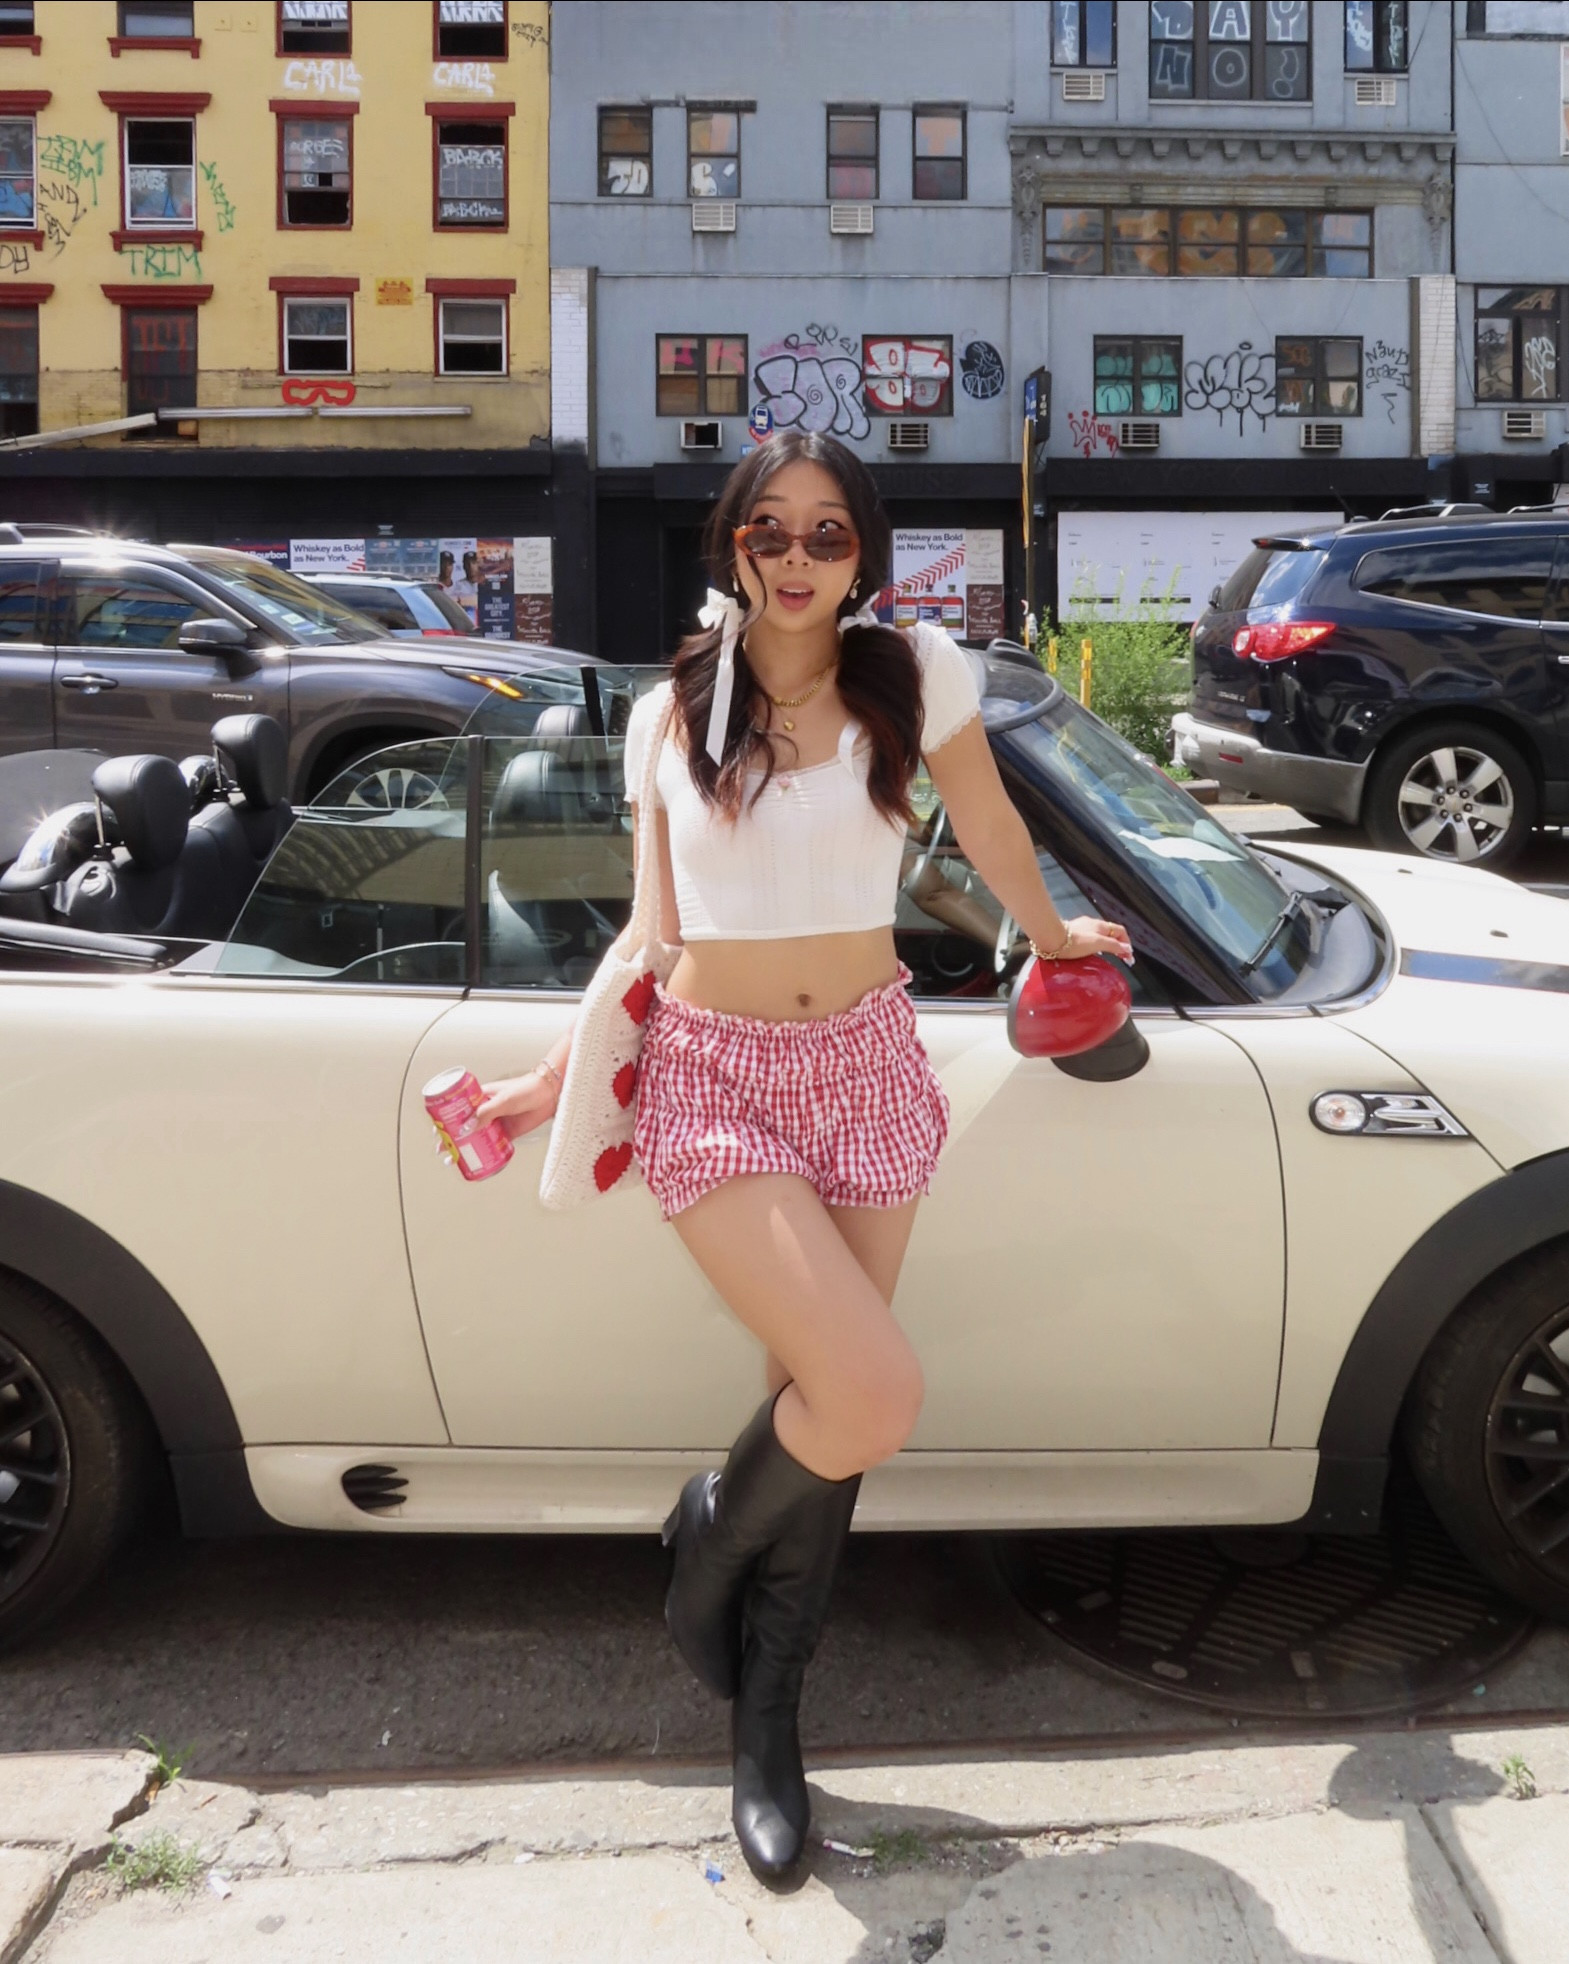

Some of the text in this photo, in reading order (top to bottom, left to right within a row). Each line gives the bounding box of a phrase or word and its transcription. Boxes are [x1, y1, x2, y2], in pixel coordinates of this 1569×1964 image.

[895, 533, 932, 543] Whiskey
[943, 533, 963, 541] Bold
[293, 544, 331, 553] Whiskey
[344, 544, 365, 552] Bold
[907, 543, 926, 551] New
